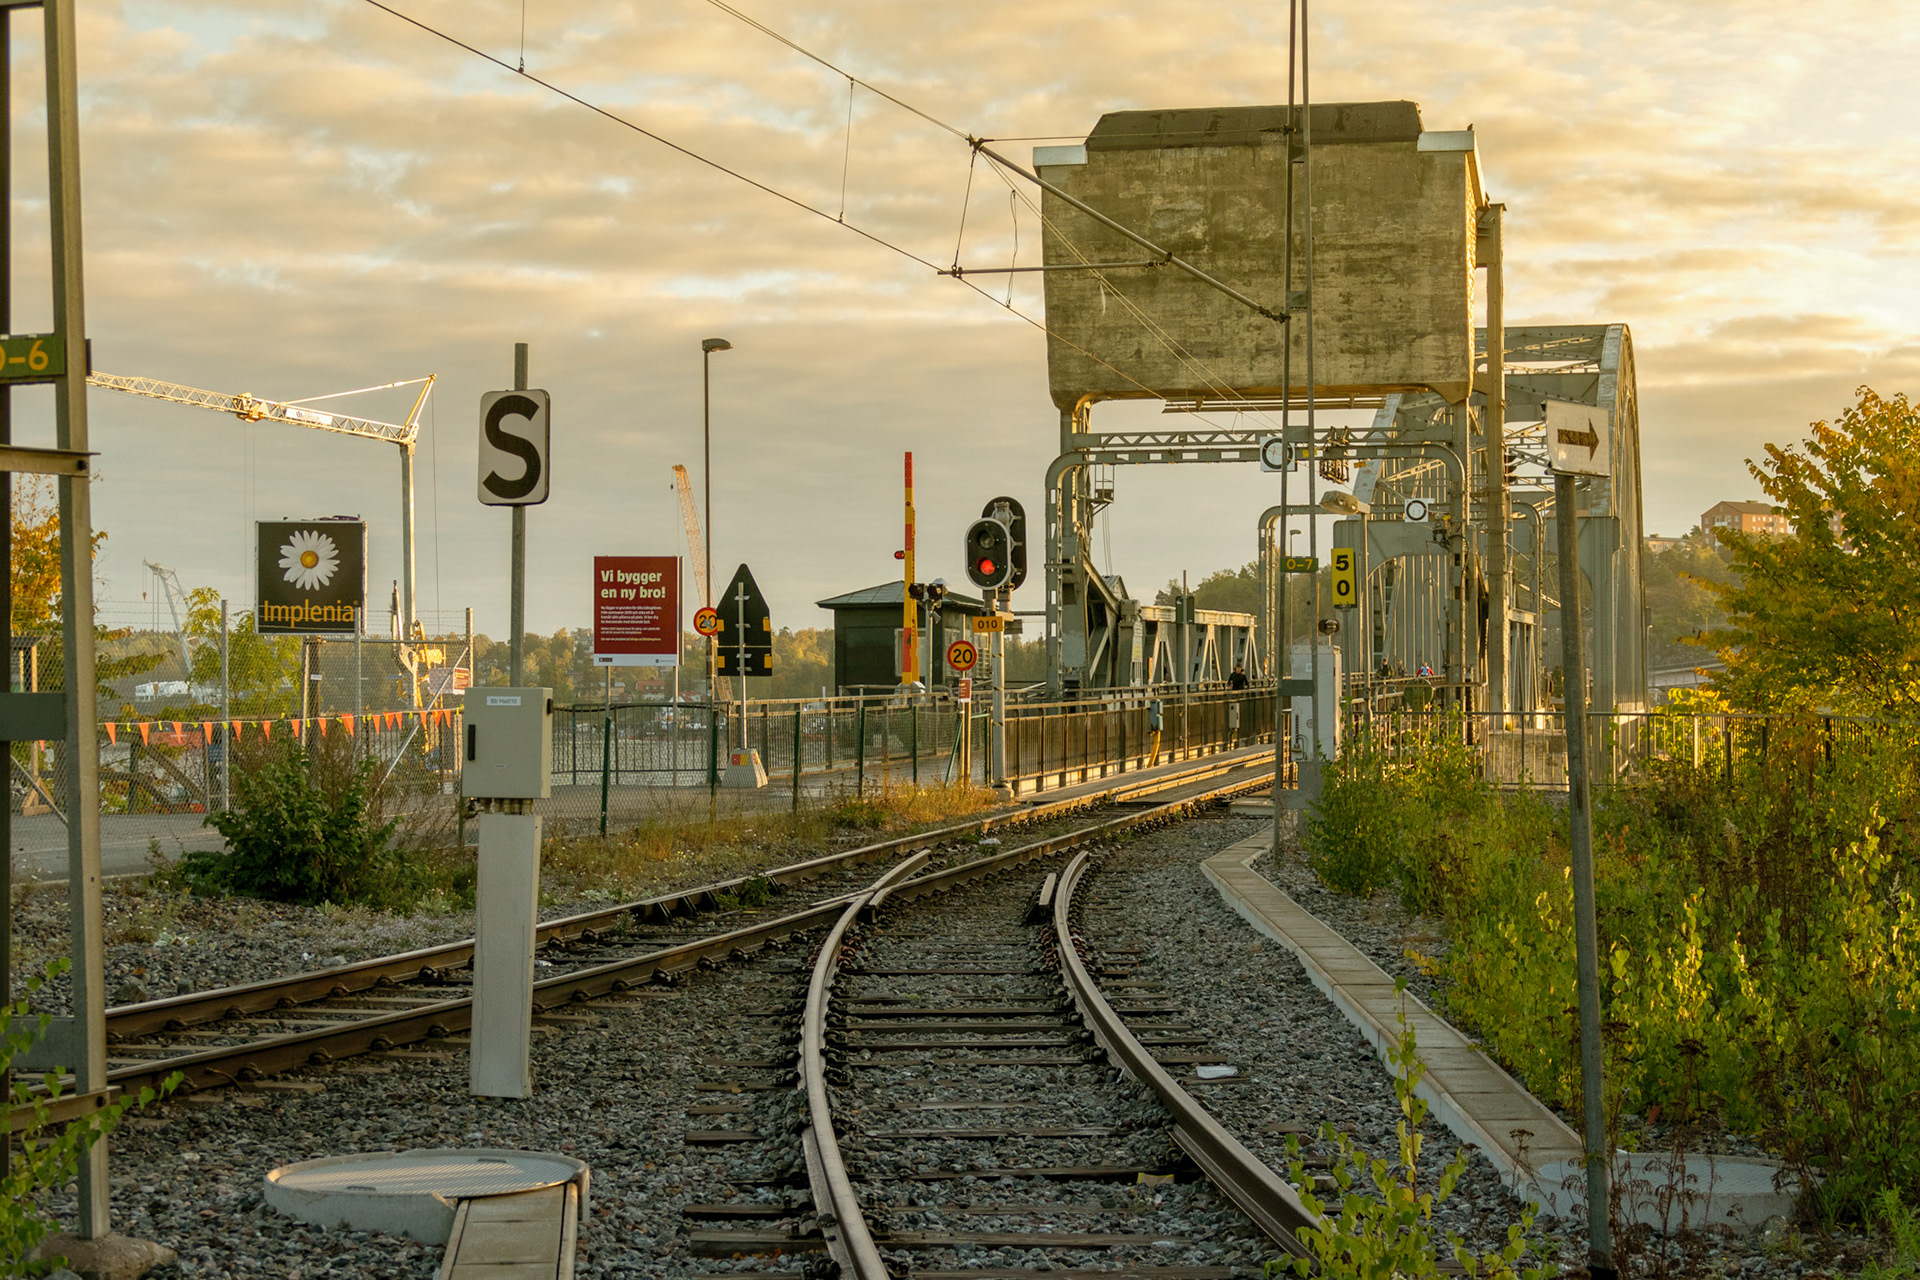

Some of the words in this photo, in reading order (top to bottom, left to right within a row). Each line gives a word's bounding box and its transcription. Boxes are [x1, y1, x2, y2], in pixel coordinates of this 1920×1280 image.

[482, 395, 541, 499] S
[601, 569, 614, 582] Vi
[617, 569, 662, 585] bygger
[601, 588, 617, 598] en
[620, 588, 637, 601] ny
[640, 586, 666, 598] bro!
[264, 599, 354, 628] Implenia
[699, 614, 717, 629] 20
[978, 620, 998, 629] 010
[953, 648, 973, 664] 20
